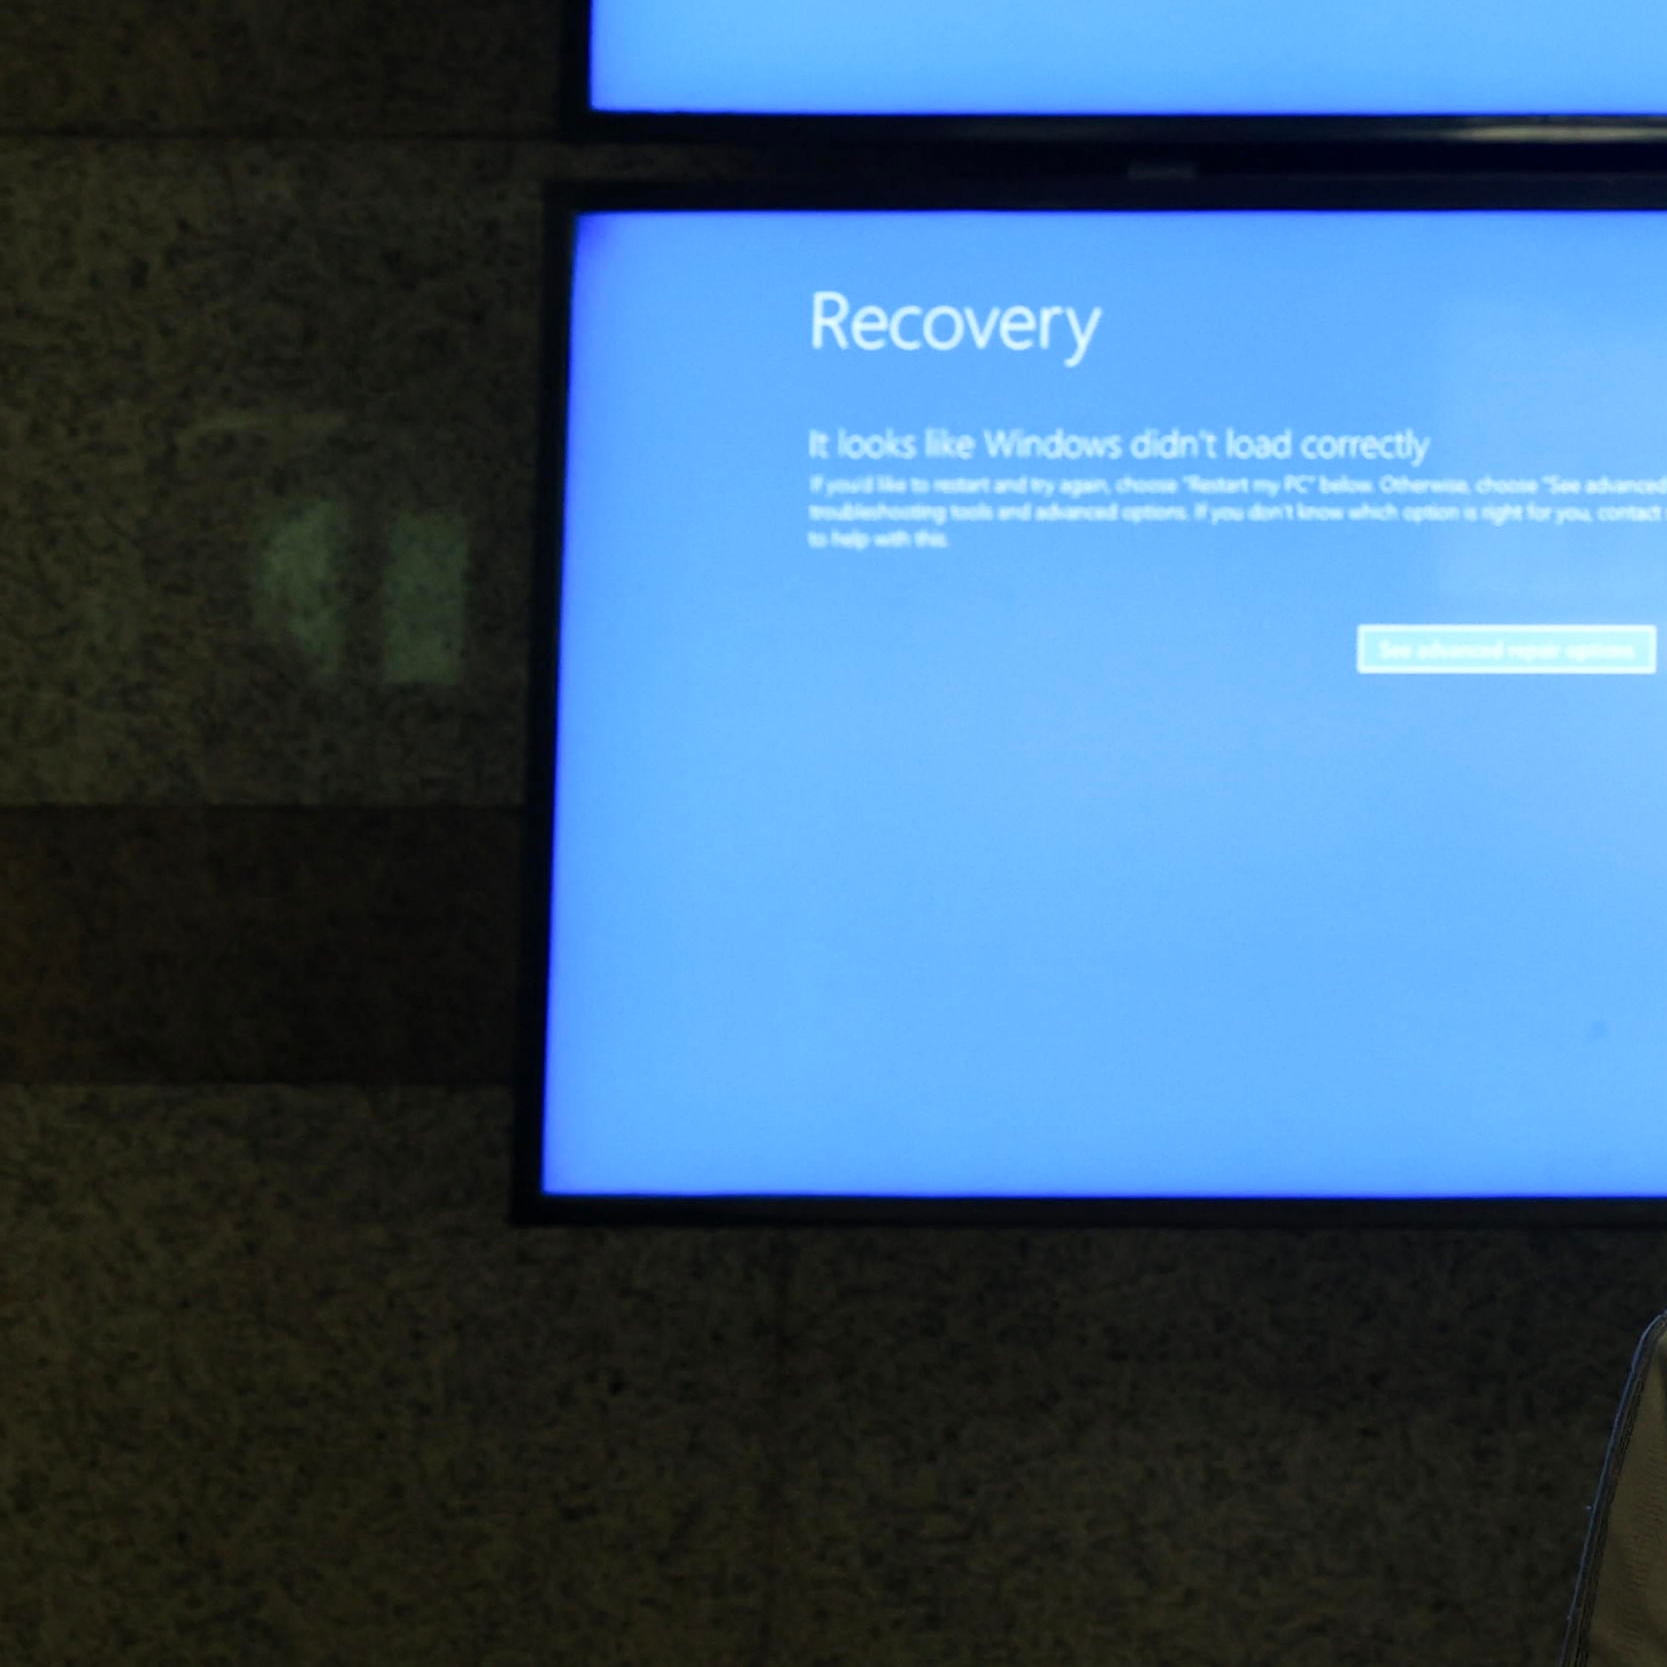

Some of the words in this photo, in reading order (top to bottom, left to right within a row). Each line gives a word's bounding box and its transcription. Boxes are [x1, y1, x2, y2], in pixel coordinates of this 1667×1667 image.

[811, 290, 1103, 368] Recovery
[807, 428, 831, 460] It
[836, 428, 918, 460] looks
[924, 427, 977, 461] like
[983, 427, 1124, 460] Windows
[1129, 427, 1218, 460] didn't
[1225, 426, 1293, 460] load
[1299, 427, 1431, 465] correctly
